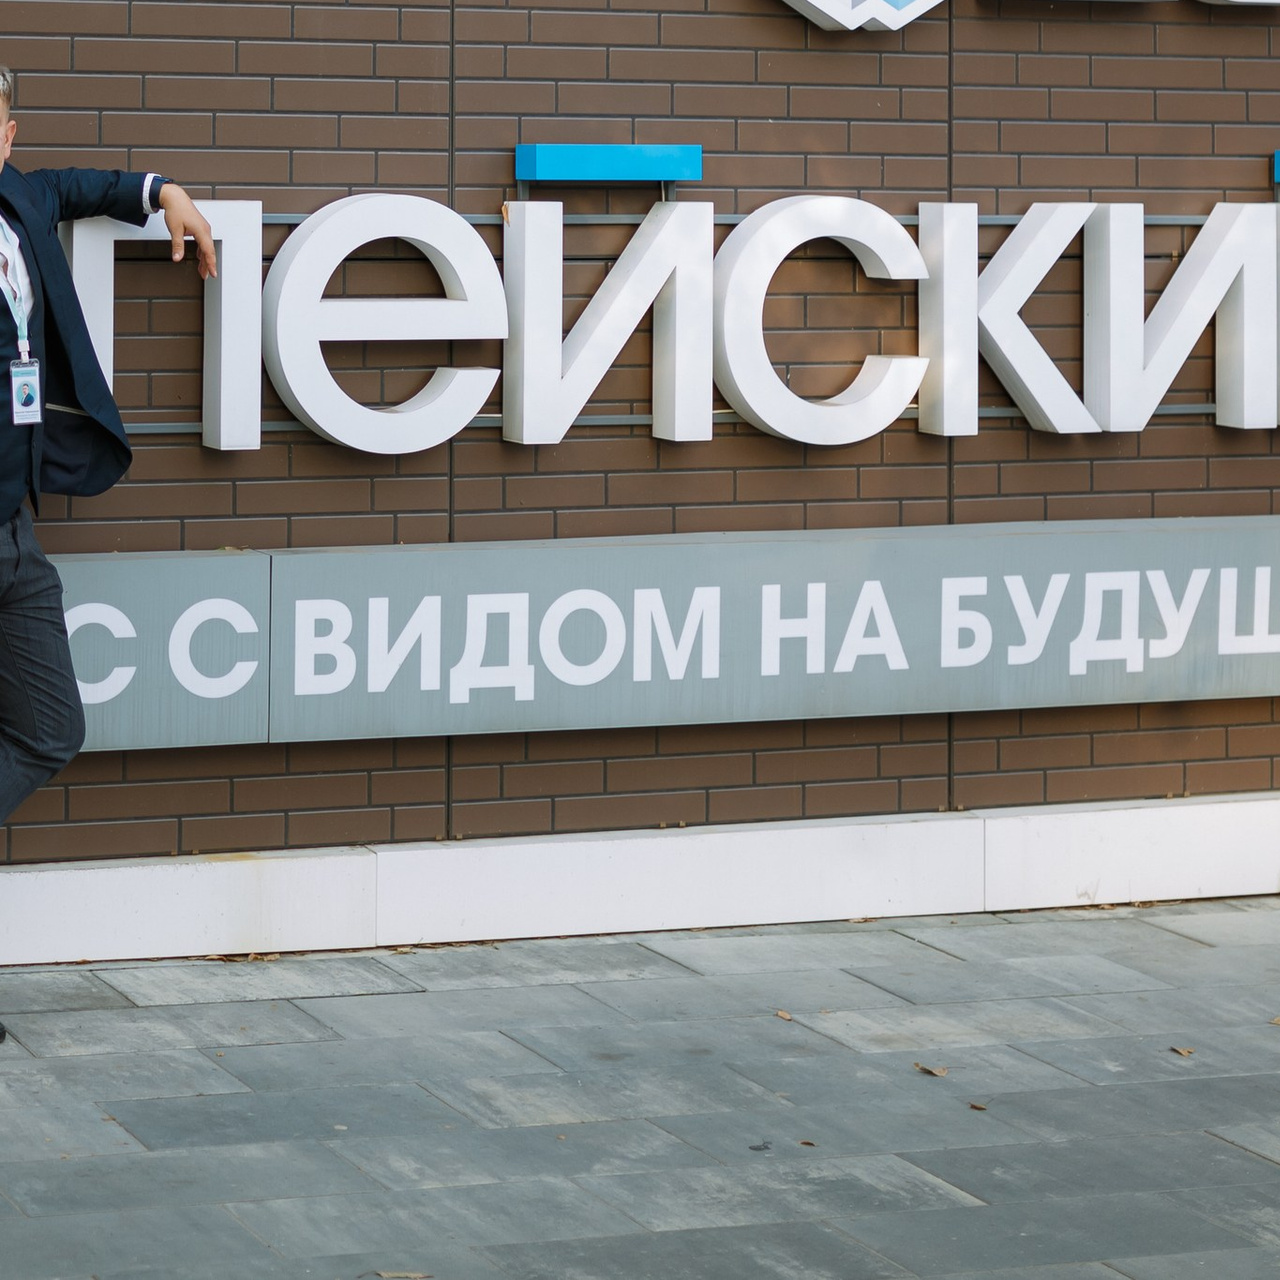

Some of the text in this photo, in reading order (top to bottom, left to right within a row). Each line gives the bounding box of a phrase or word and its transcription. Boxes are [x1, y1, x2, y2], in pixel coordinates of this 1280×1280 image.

[168, 598, 259, 699] С
[294, 586, 720, 704] ВИДОМ
[761, 580, 909, 676] НА
